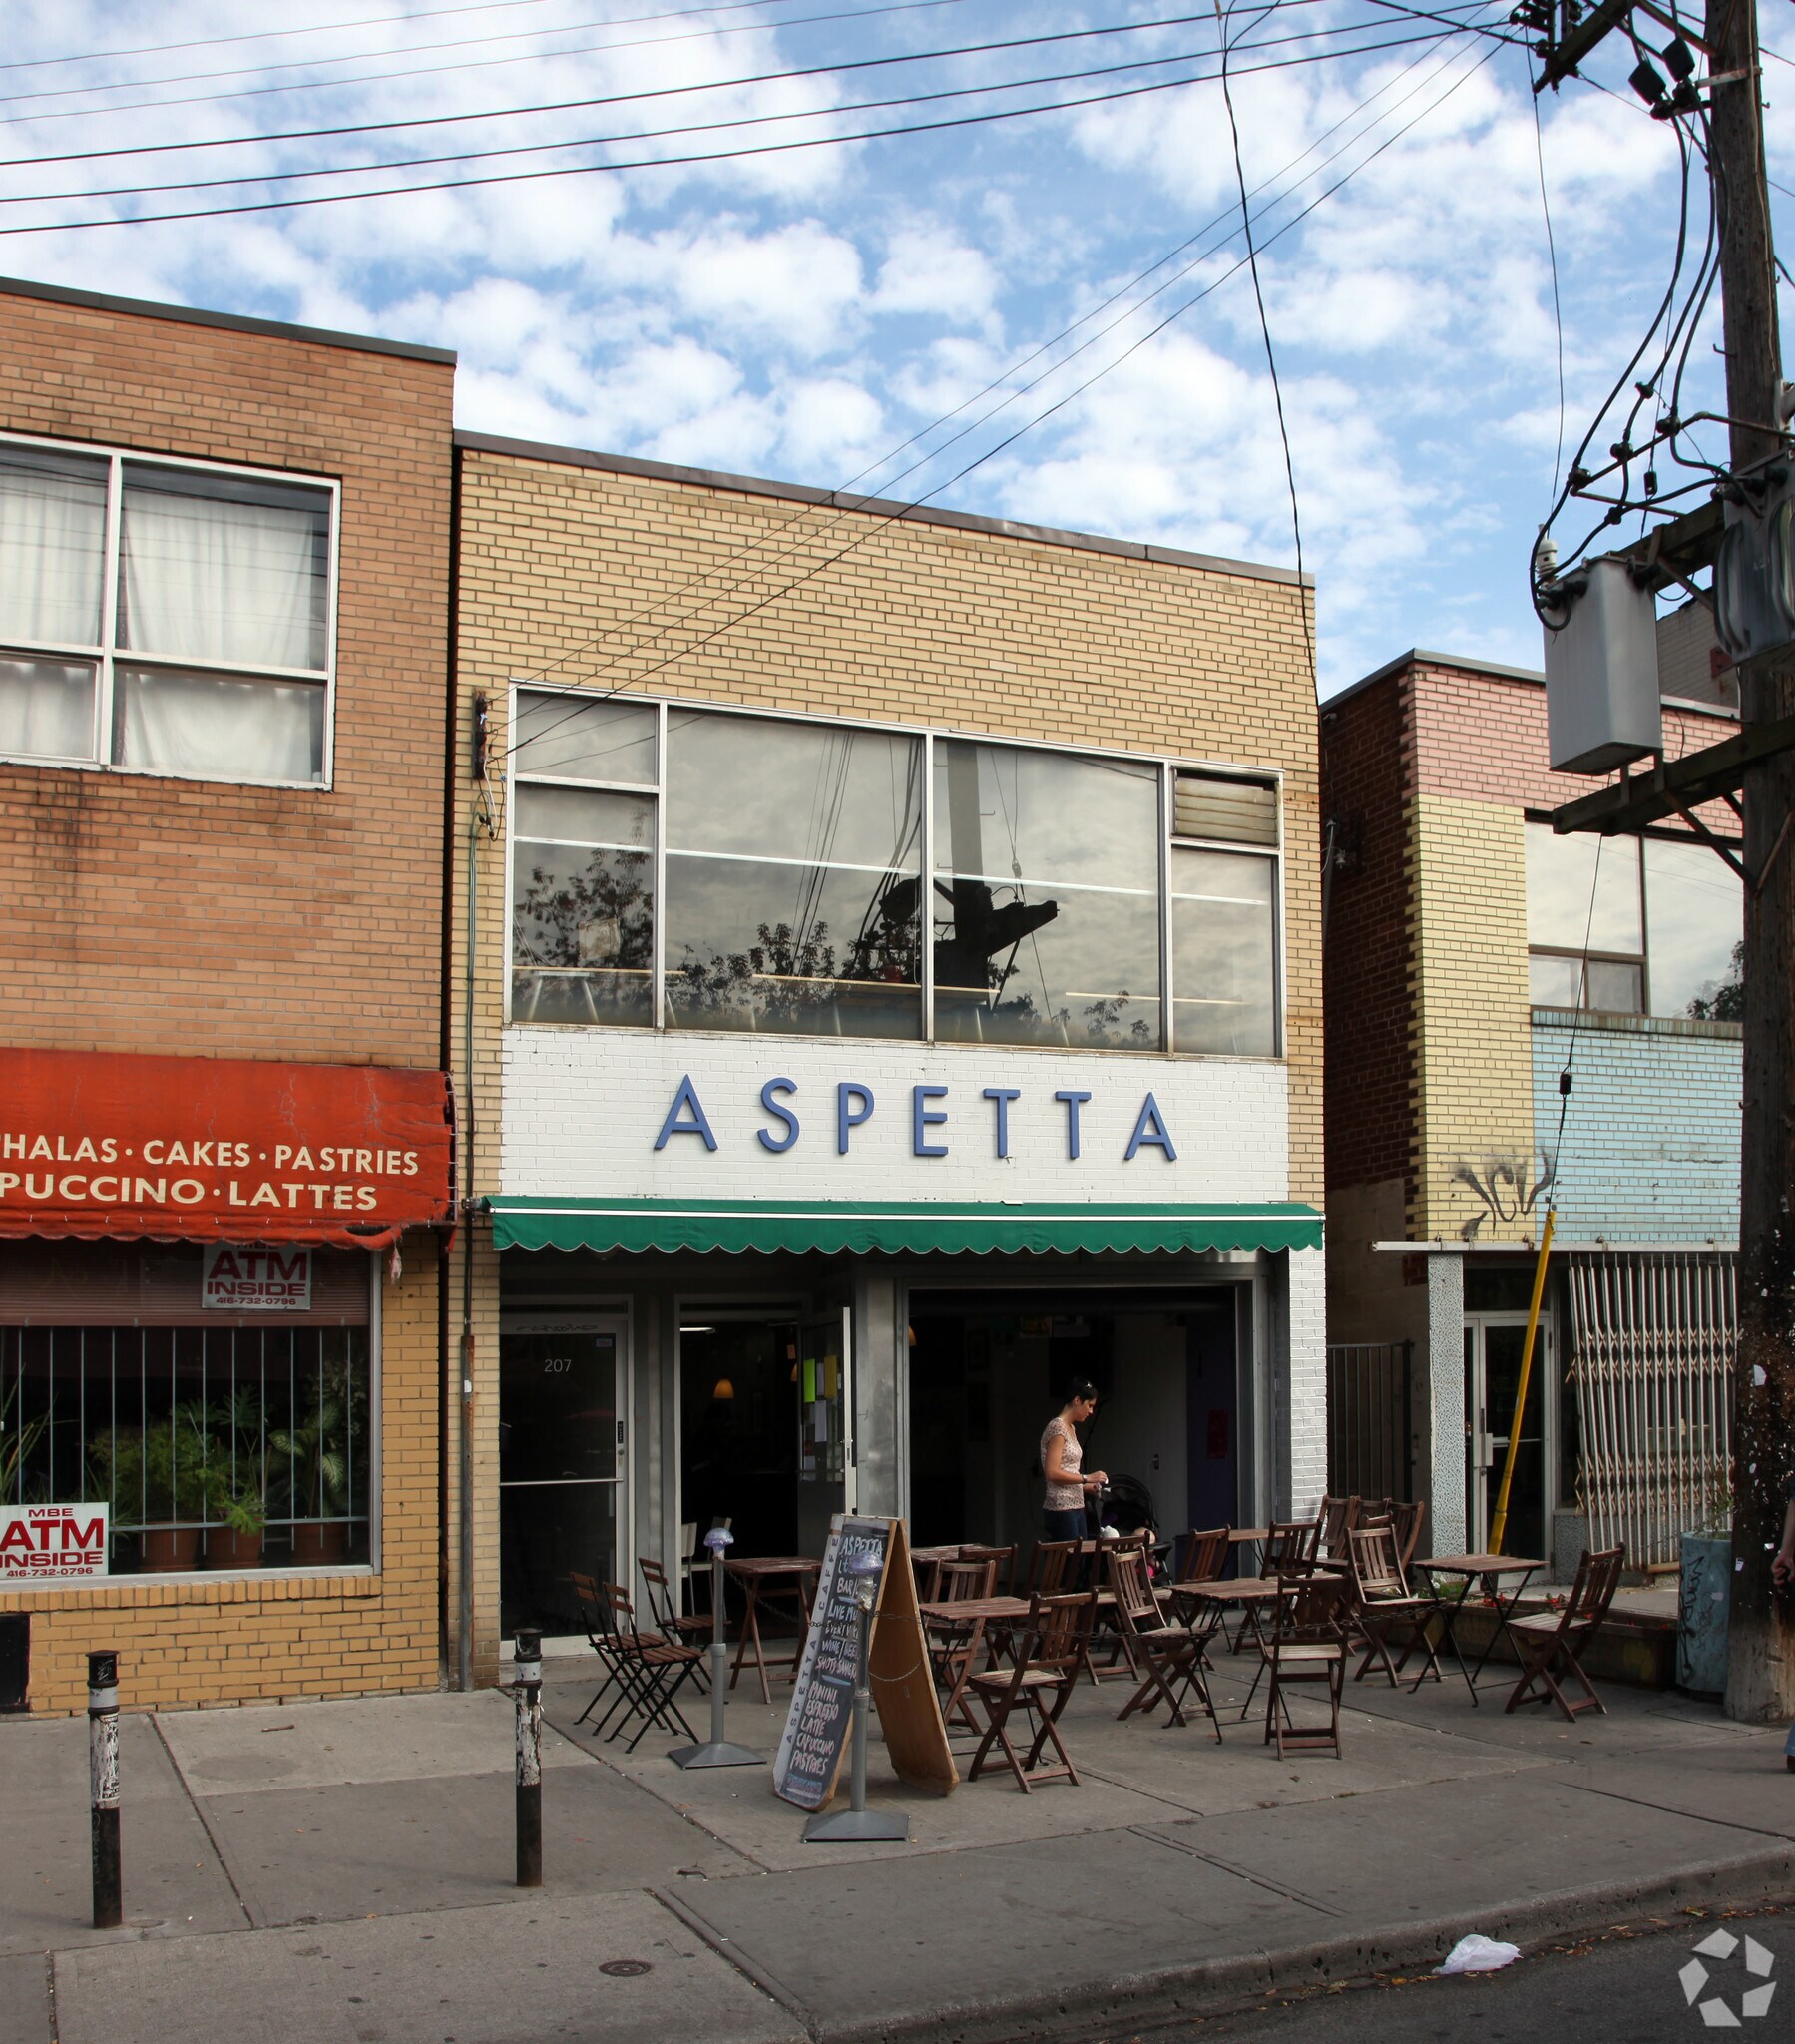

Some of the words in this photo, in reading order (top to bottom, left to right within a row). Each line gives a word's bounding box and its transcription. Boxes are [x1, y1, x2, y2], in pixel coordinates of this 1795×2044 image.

[653, 1073, 1177, 1161] ASPETTA
[0, 1134, 117, 1164] HALAS
[143, 1140, 250, 1167] CAKES
[274, 1144, 419, 1176] PASTRIES
[229, 1180, 378, 1211] LATTES
[208, 1250, 307, 1281] ATM
[208, 1281, 305, 1296] INSIDE
[544, 1359, 572, 1372] 207
[28, 1508, 73, 1517] MBE
[0, 1518, 104, 1552] ATM
[7, 1567, 93, 1577] 416-732-0796
[827, 1598, 845, 1618] LIVE
[786, 1640, 816, 1744] ASPETTA
[818, 1538, 838, 1611] CAFFE
[808, 1681, 838, 1703] PANINI
[805, 1698, 839, 1721] ESPRESSO
[800, 1716, 826, 1735] LATTE
